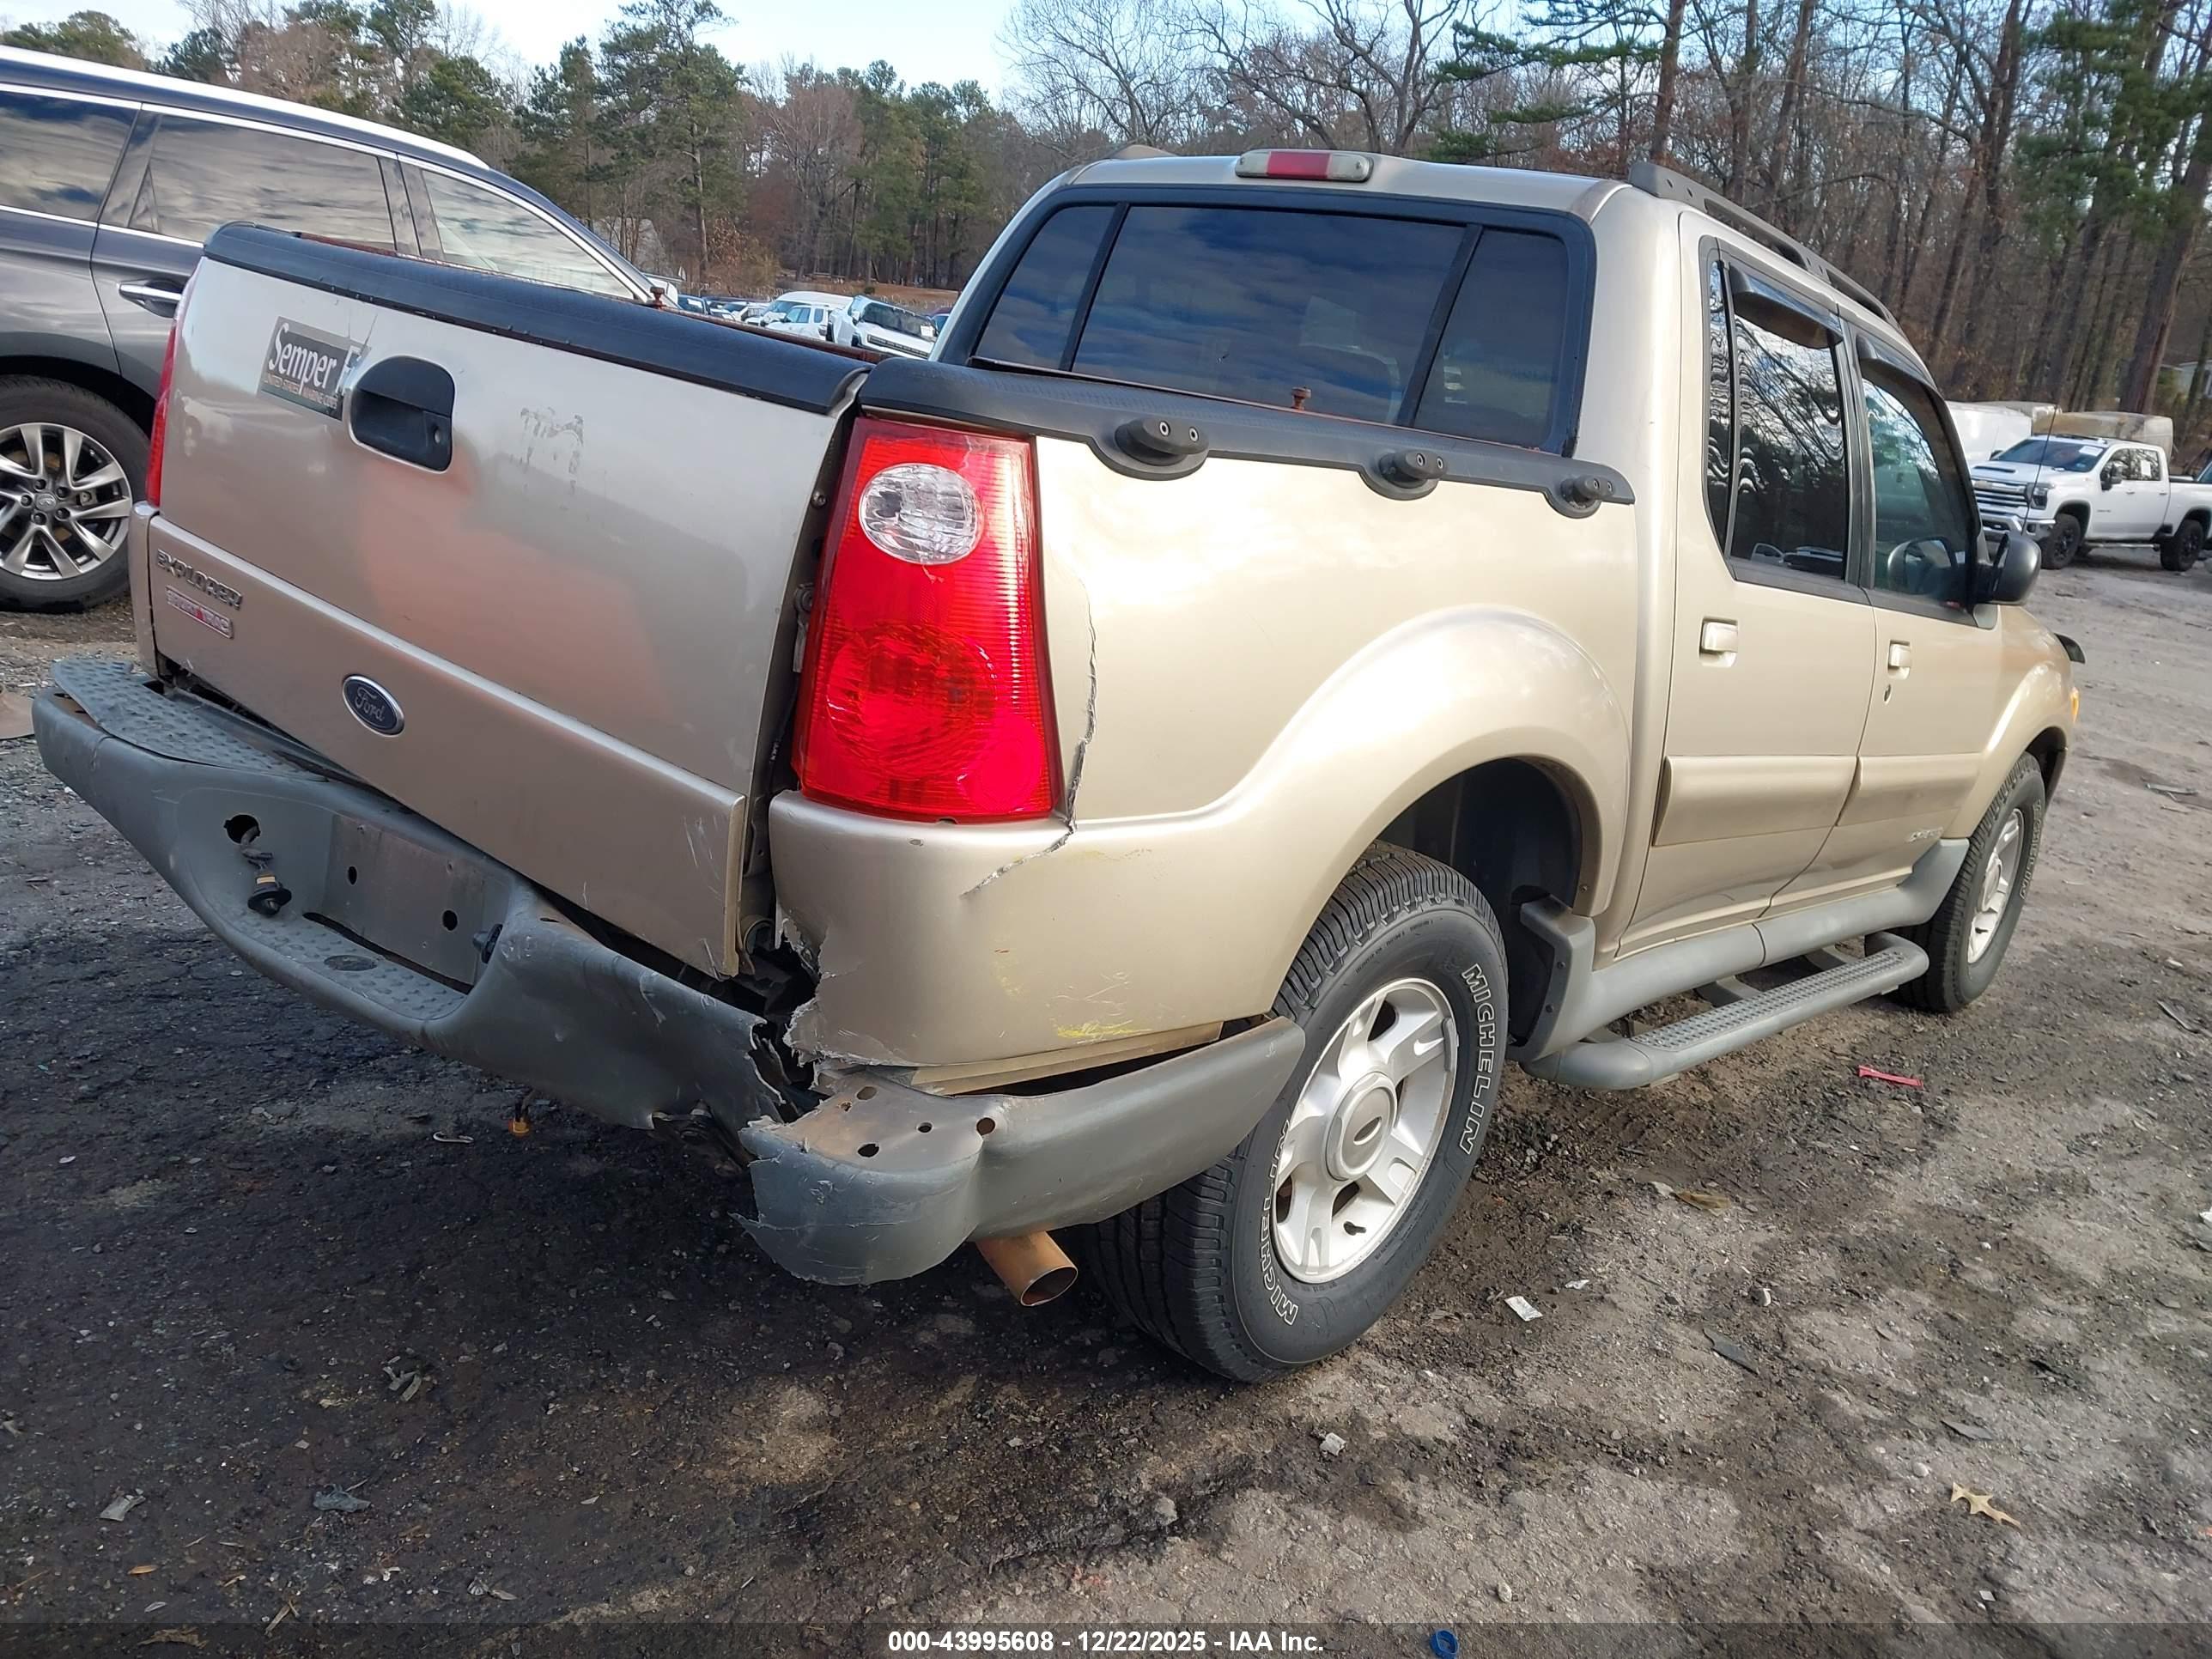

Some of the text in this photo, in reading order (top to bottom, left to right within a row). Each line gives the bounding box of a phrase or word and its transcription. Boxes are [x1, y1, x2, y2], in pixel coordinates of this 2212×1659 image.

[268, 322, 337, 395] Semper
[157, 548, 243, 611] EXPLORER
[354, 686, 386, 722] Ford
[1461, 963, 1496, 1155] MICHELIN
